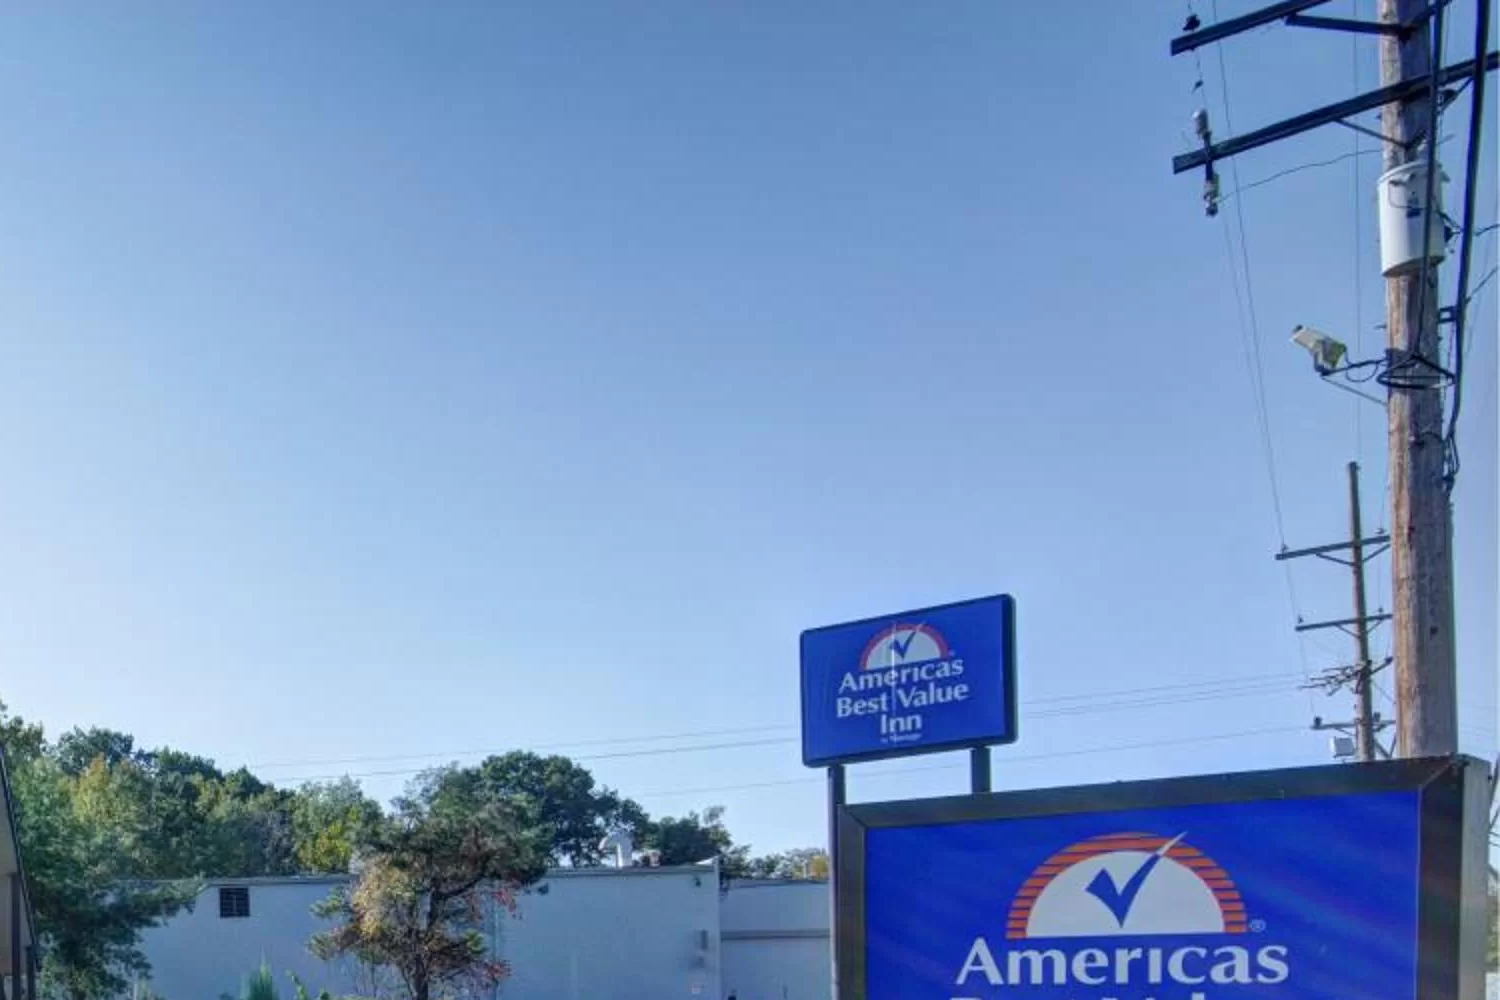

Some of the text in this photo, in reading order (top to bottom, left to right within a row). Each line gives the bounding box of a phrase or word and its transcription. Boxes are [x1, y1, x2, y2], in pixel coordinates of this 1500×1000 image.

[838, 658, 964, 693] Americas
[836, 682, 968, 718] Best Value
[880, 714, 922, 734] Inn
[956, 937, 1289, 985] Americas
